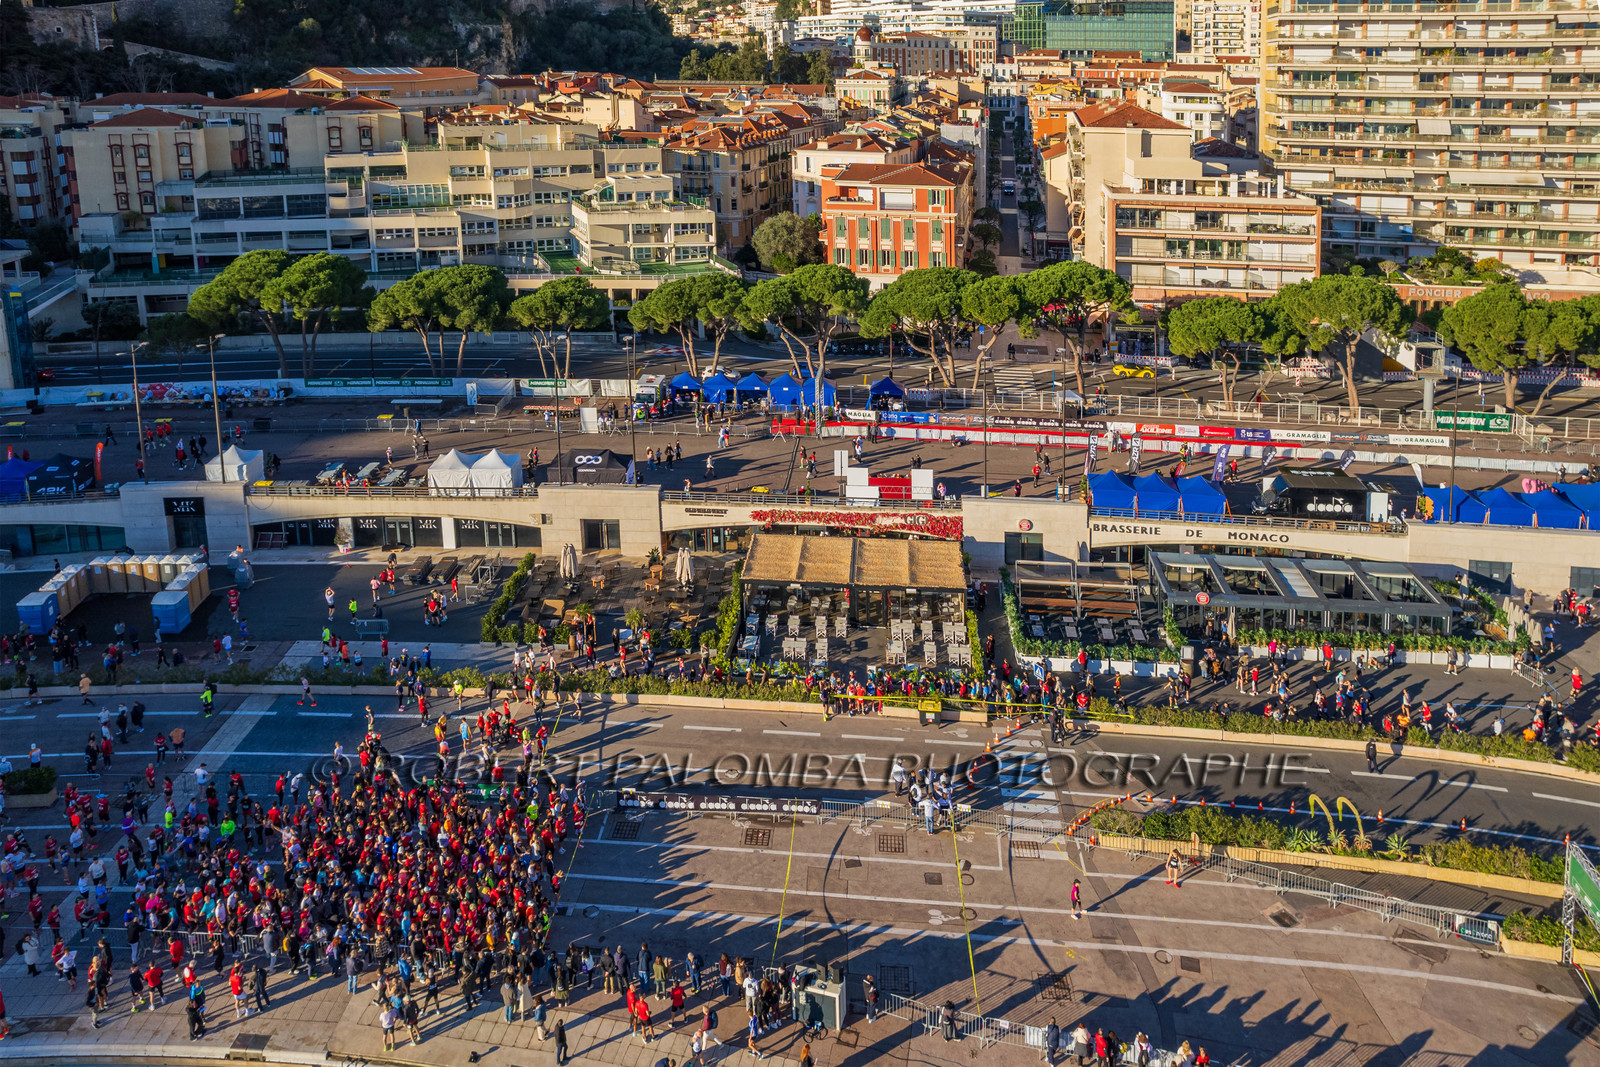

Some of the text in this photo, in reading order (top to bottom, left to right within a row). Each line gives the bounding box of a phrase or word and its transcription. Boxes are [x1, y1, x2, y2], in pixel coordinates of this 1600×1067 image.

[1408, 288, 1462, 298] FONCIER
[1306, 496, 1353, 513] diadora
[1092, 523, 1290, 543] BRASSERIE DE MONACO
